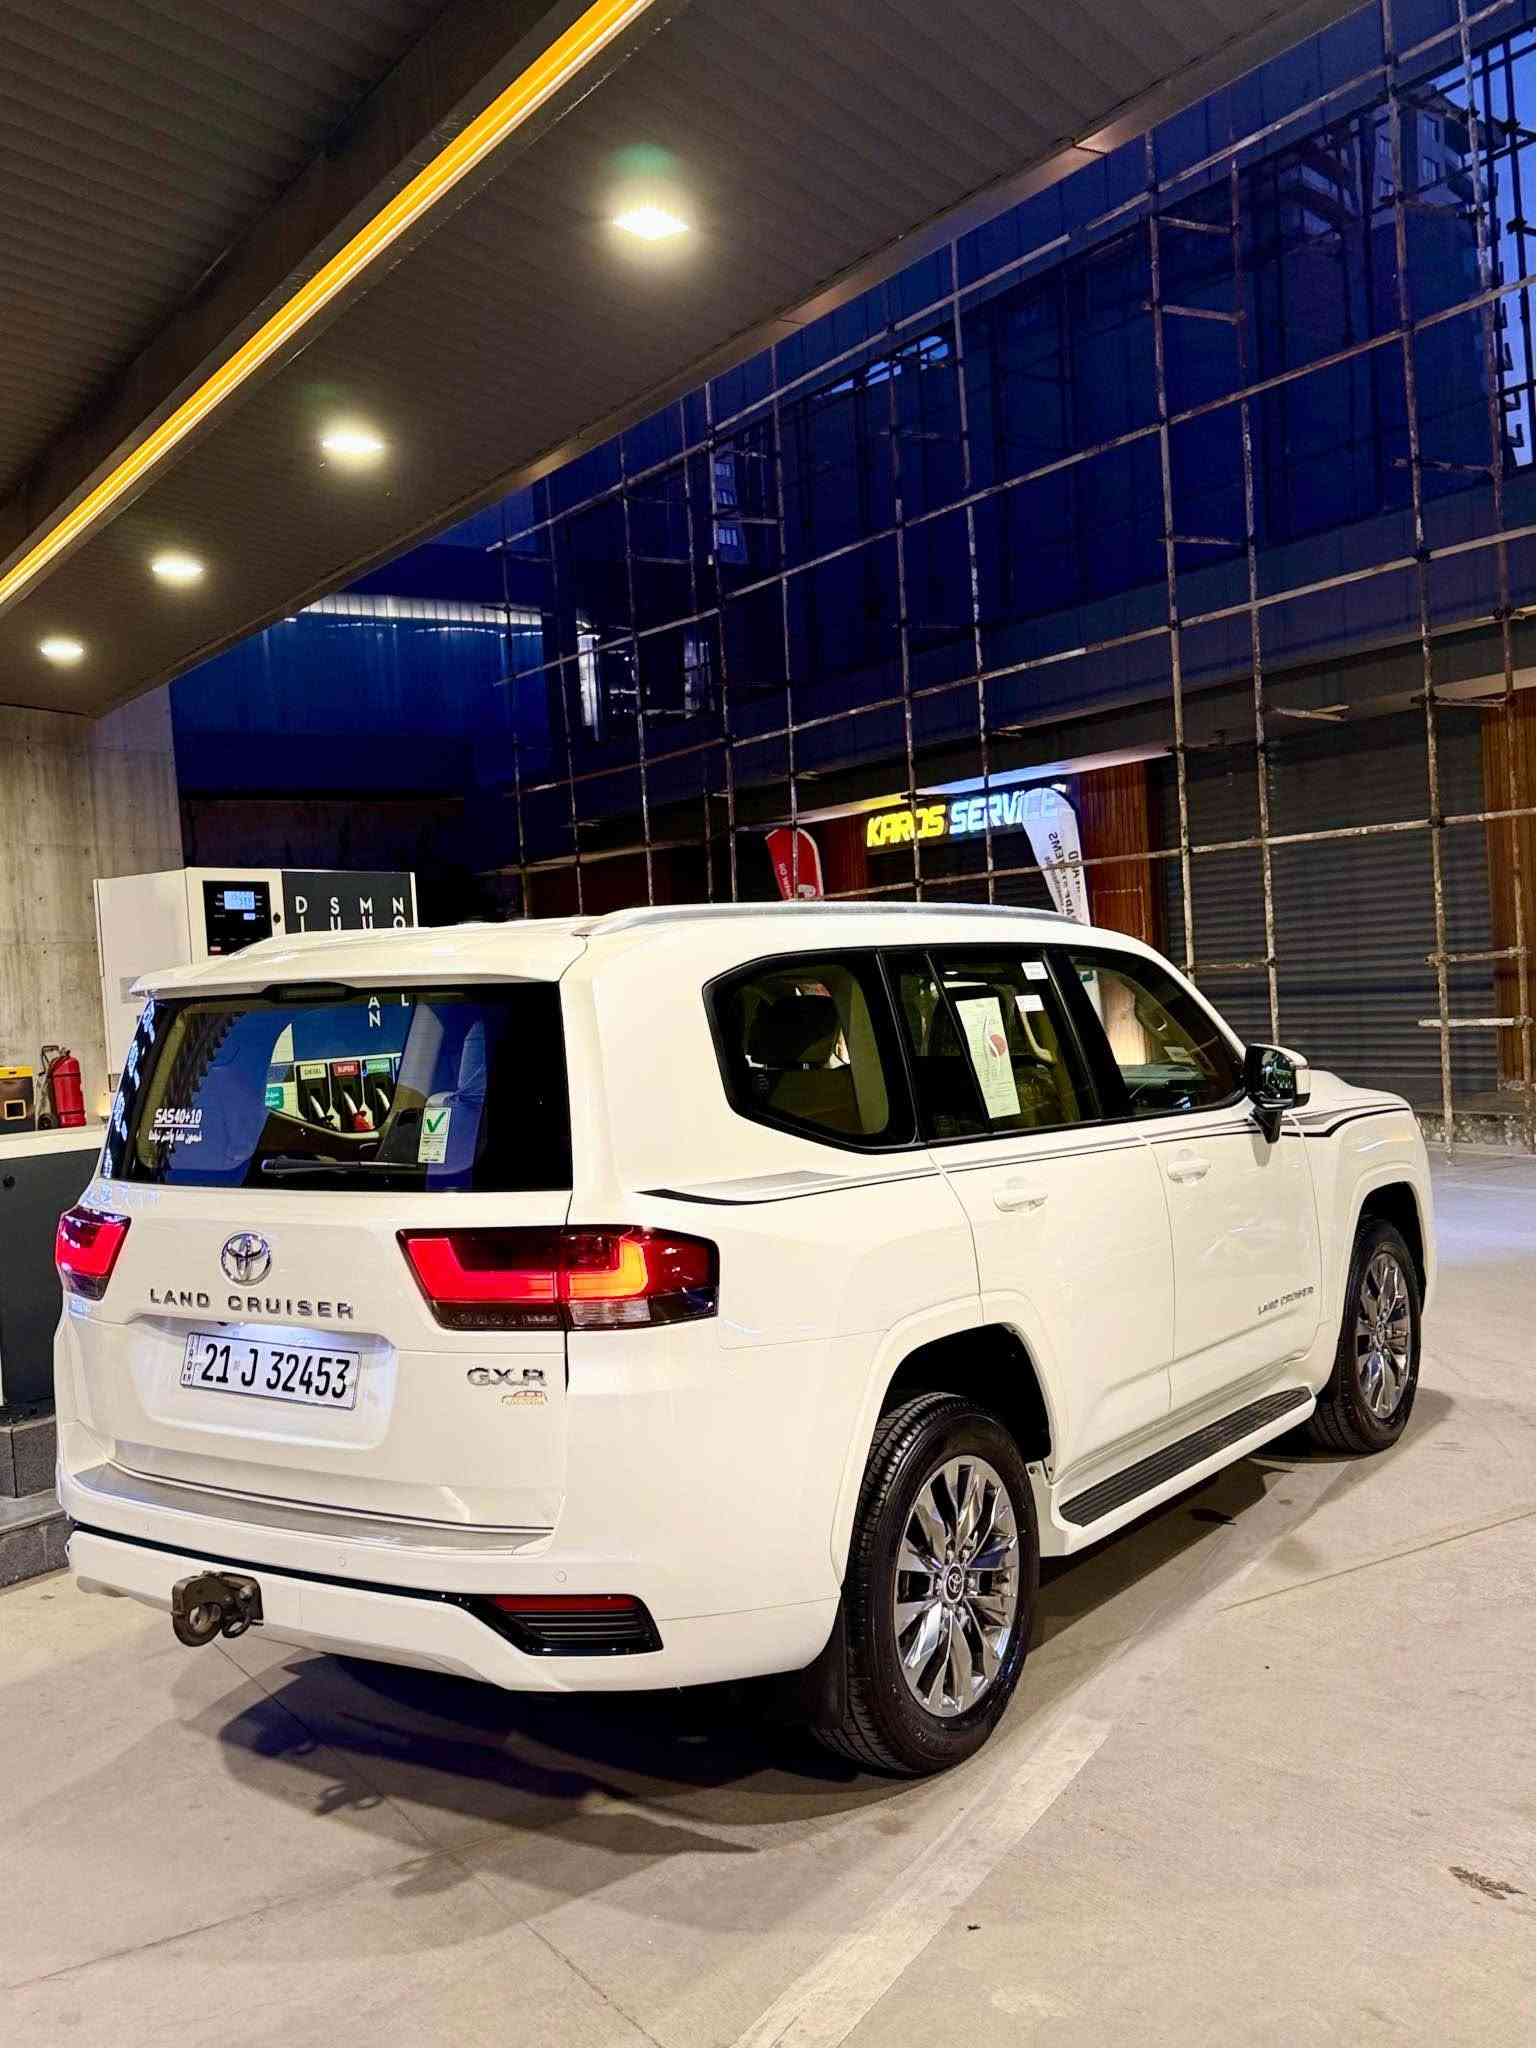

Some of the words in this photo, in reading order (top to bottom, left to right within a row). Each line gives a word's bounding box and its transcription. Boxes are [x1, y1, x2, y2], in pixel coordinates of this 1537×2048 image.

[867, 804, 946, 847] KAROS
[150, 1288, 210, 1308] LAND
[228, 1295, 354, 1319] CRUISER
[201, 1343, 231, 1383] 21
[241, 1348, 259, 1386] J
[266, 1351, 351, 1398] 32453
[467, 1367, 547, 1386] GXR
